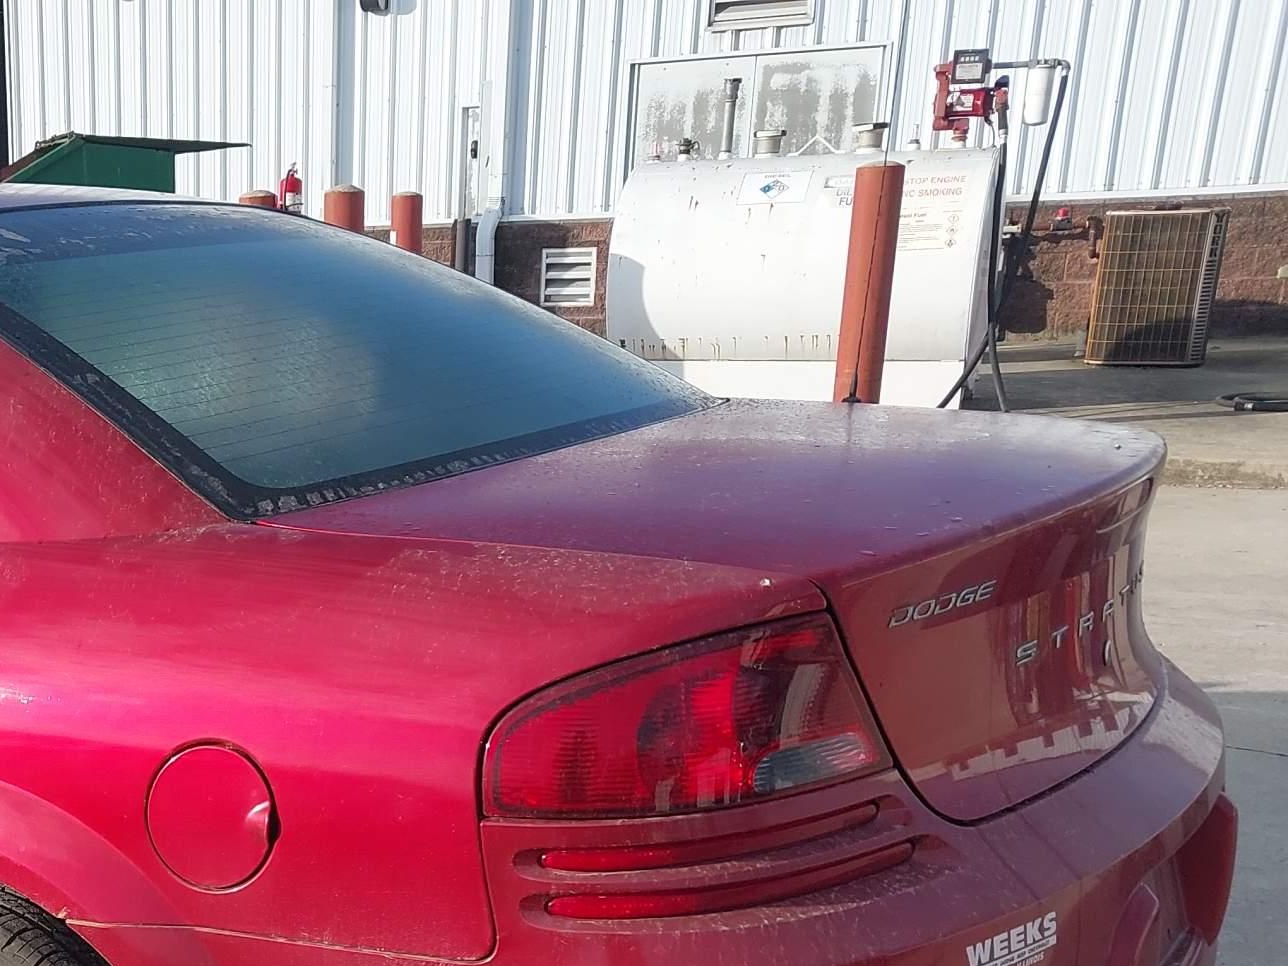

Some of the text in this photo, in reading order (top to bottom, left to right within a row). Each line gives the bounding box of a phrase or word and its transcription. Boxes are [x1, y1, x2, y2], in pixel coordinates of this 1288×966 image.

[931, 175, 967, 184] ENGINE
[917, 187, 963, 198] SMOKING
[839, 197, 853, 206] FU
[888, 579, 997, 629] DODGE
